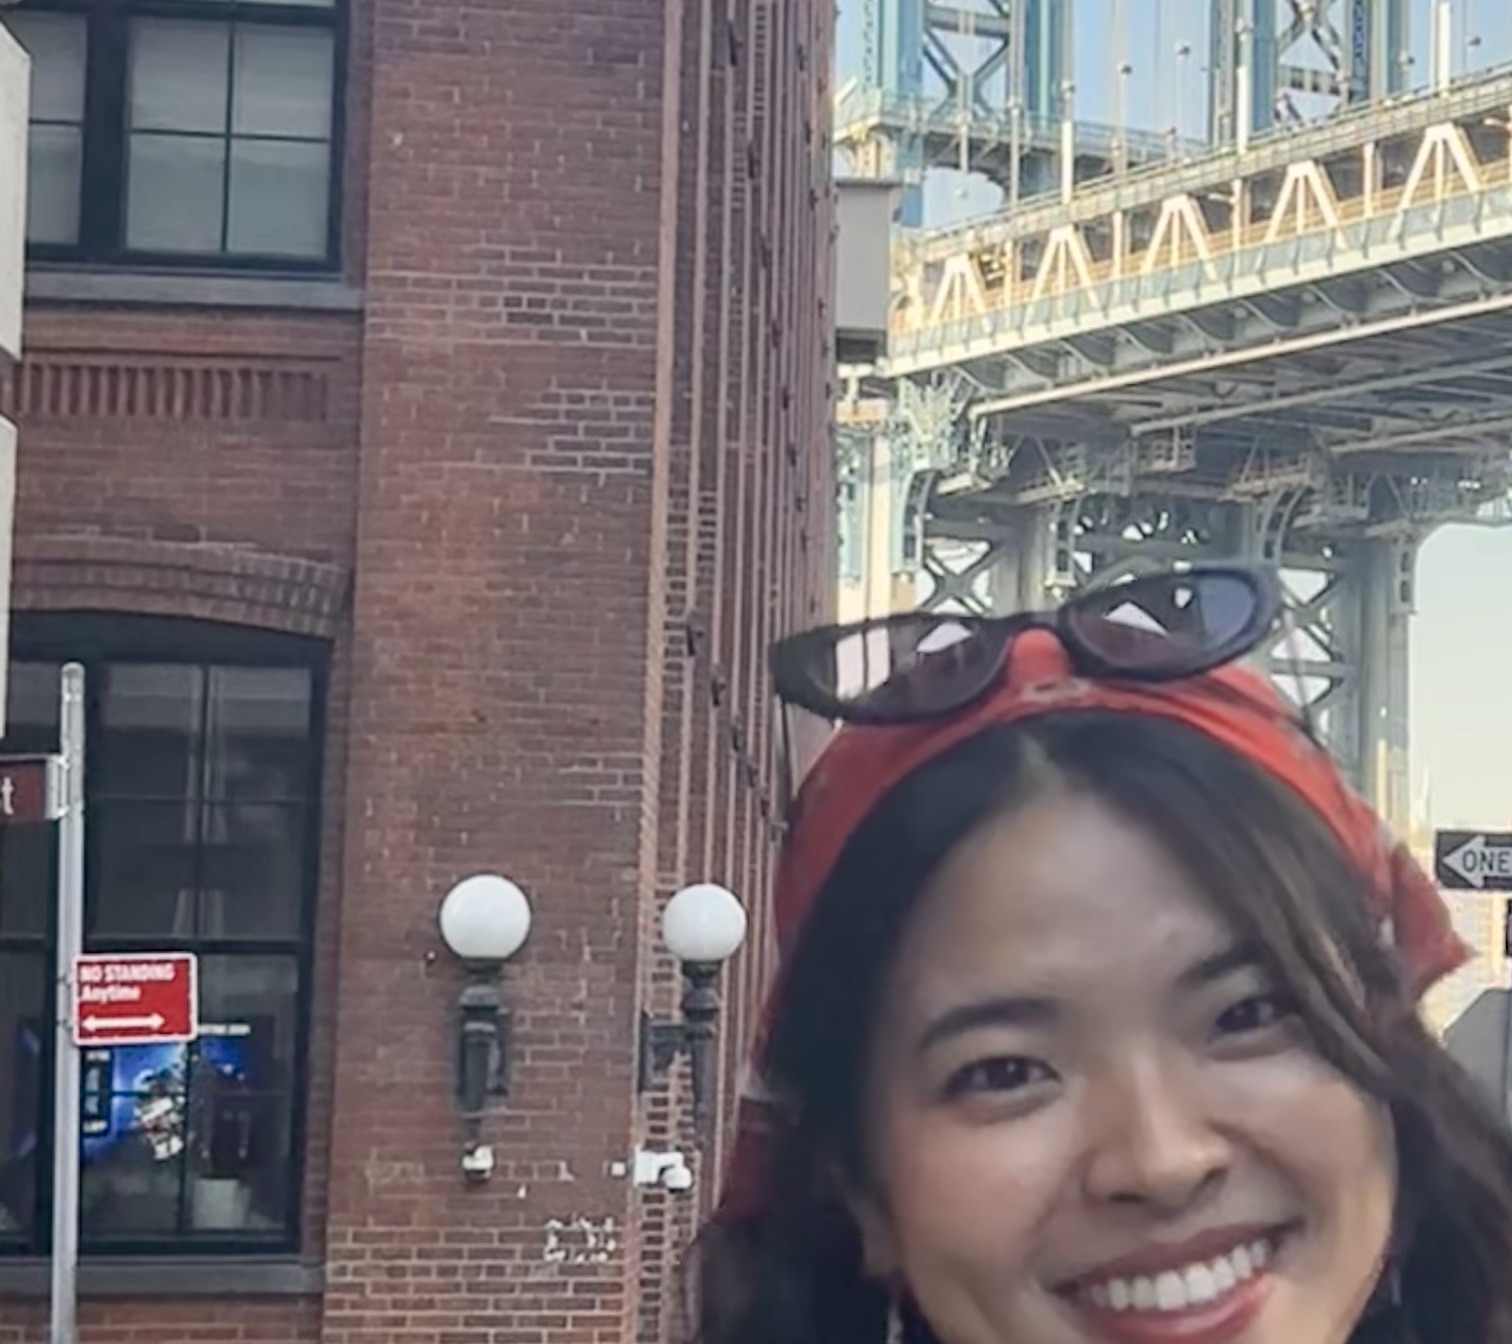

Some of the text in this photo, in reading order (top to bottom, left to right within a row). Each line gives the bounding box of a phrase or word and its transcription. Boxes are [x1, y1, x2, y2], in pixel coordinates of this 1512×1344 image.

[0, 777, 14, 814] t
[1462, 849, 1510, 873] ONE
[80, 963, 175, 982] NO STANDING
[80, 985, 141, 1003] Anytime
